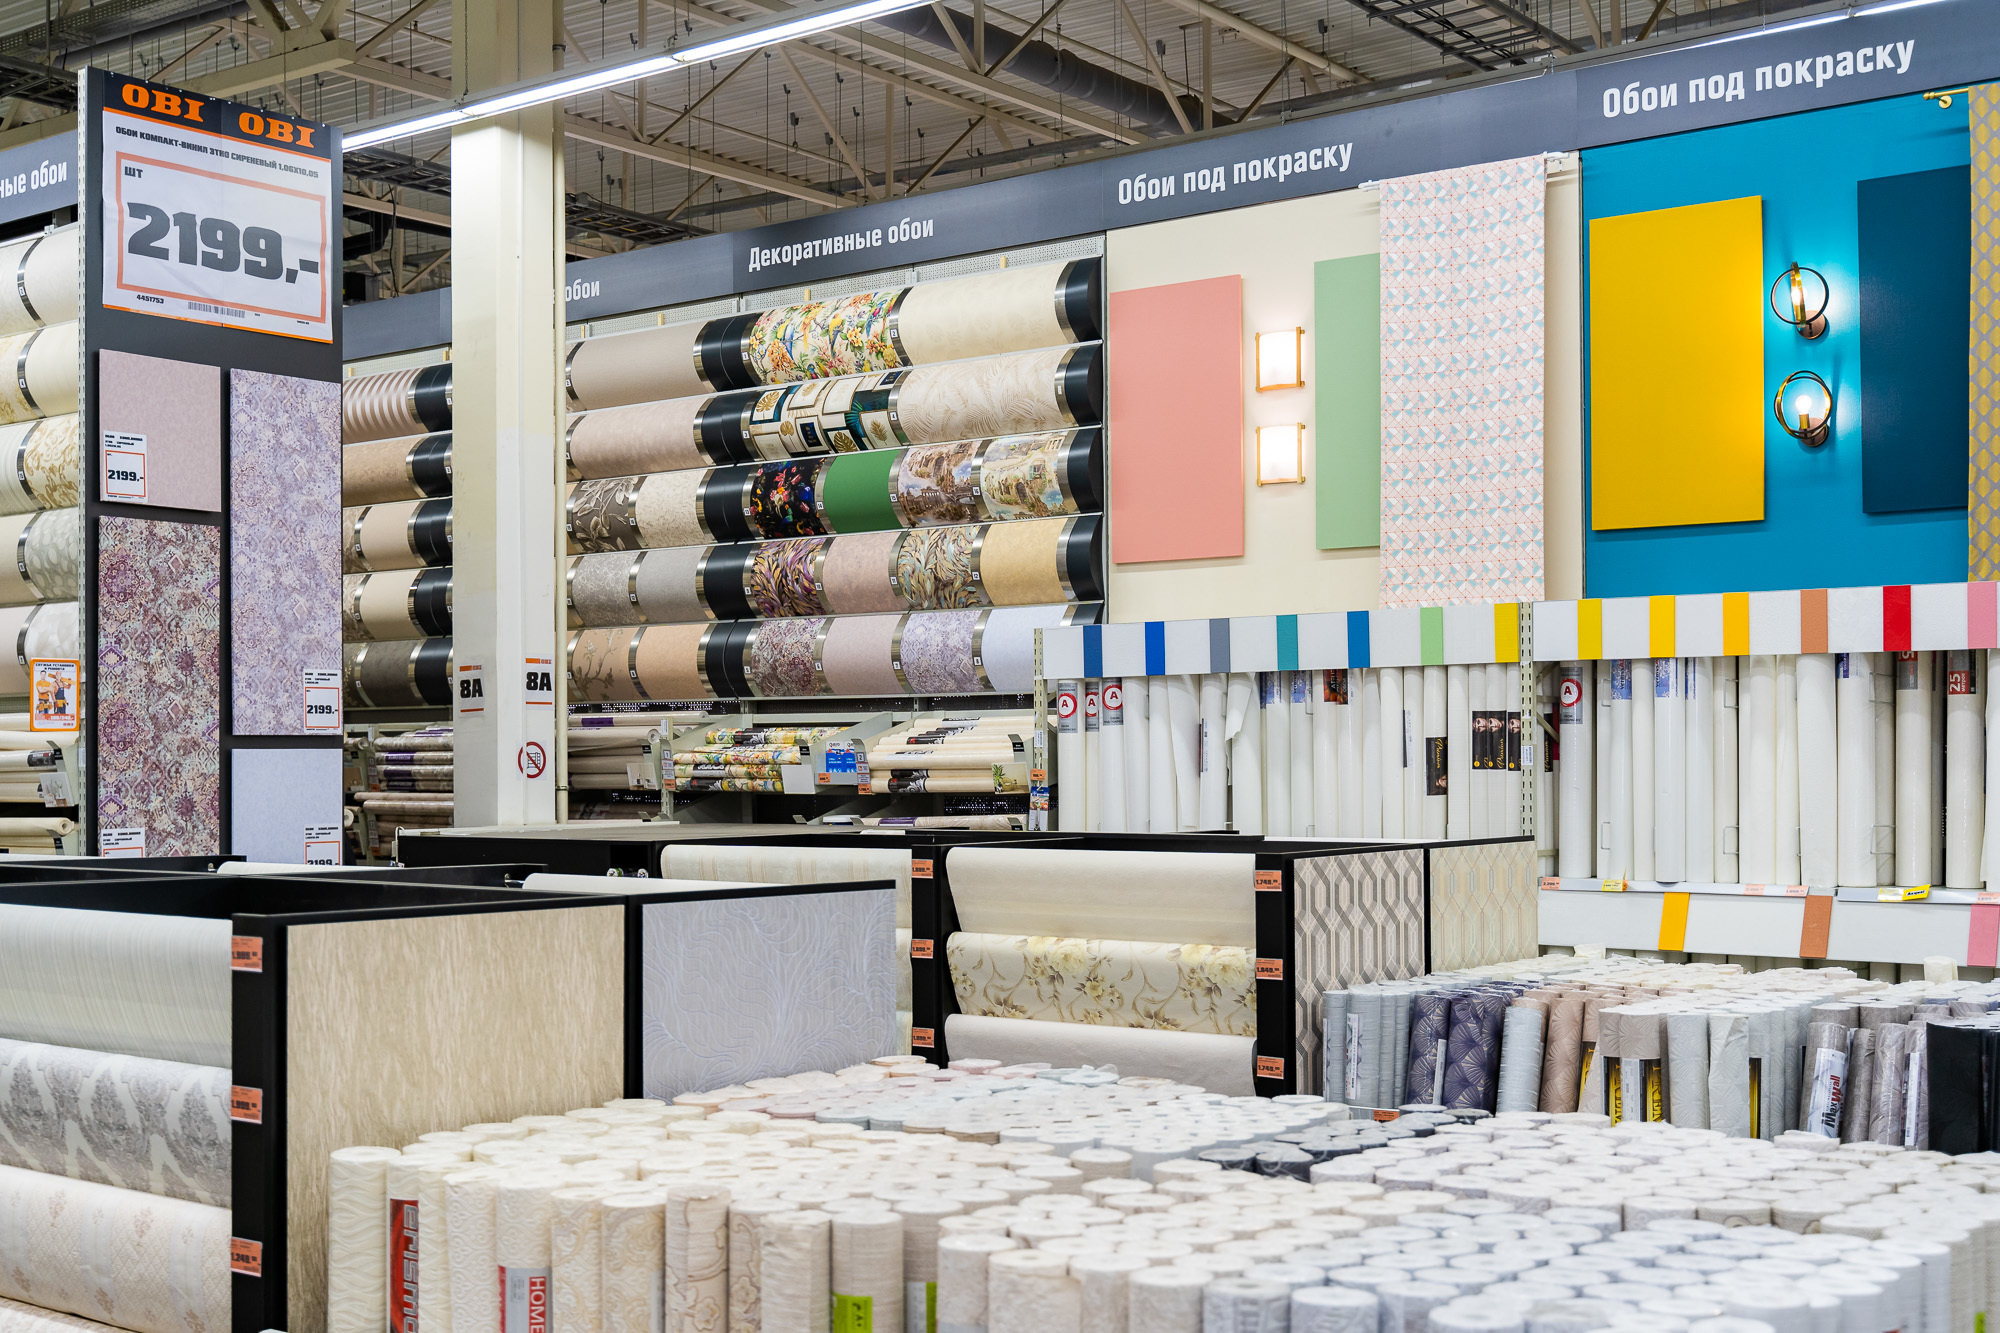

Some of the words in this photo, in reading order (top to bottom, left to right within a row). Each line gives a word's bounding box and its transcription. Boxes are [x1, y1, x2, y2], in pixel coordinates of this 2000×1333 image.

[1602, 81, 1678, 119] Обои
[1689, 71, 1745, 103] под
[1755, 39, 1915, 92] покраску
[122, 83, 205, 123] OBI
[115, 126, 138, 135] ОБОИ
[139, 130, 209, 154] КОМПАКТ-ВИНИЛ
[209, 147, 230, 159] ЭТНО
[231, 152, 277, 170] СИРЕНЕВЫЙ
[239, 112, 316, 149] OBI
[30, 160, 67, 190] обои
[124, 166, 143, 179] ШТ
[1118, 173, 1175, 205] Обои
[1183, 166, 1226, 193] под
[1233, 142, 1353, 183] покраску
[127, 202, 319, 284] 2199,-
[748, 227, 882, 273] Декоративные
[888, 216, 934, 245] обои
[136, 294, 164, 304] 4451753
[1950, 673, 1960, 692] 25
